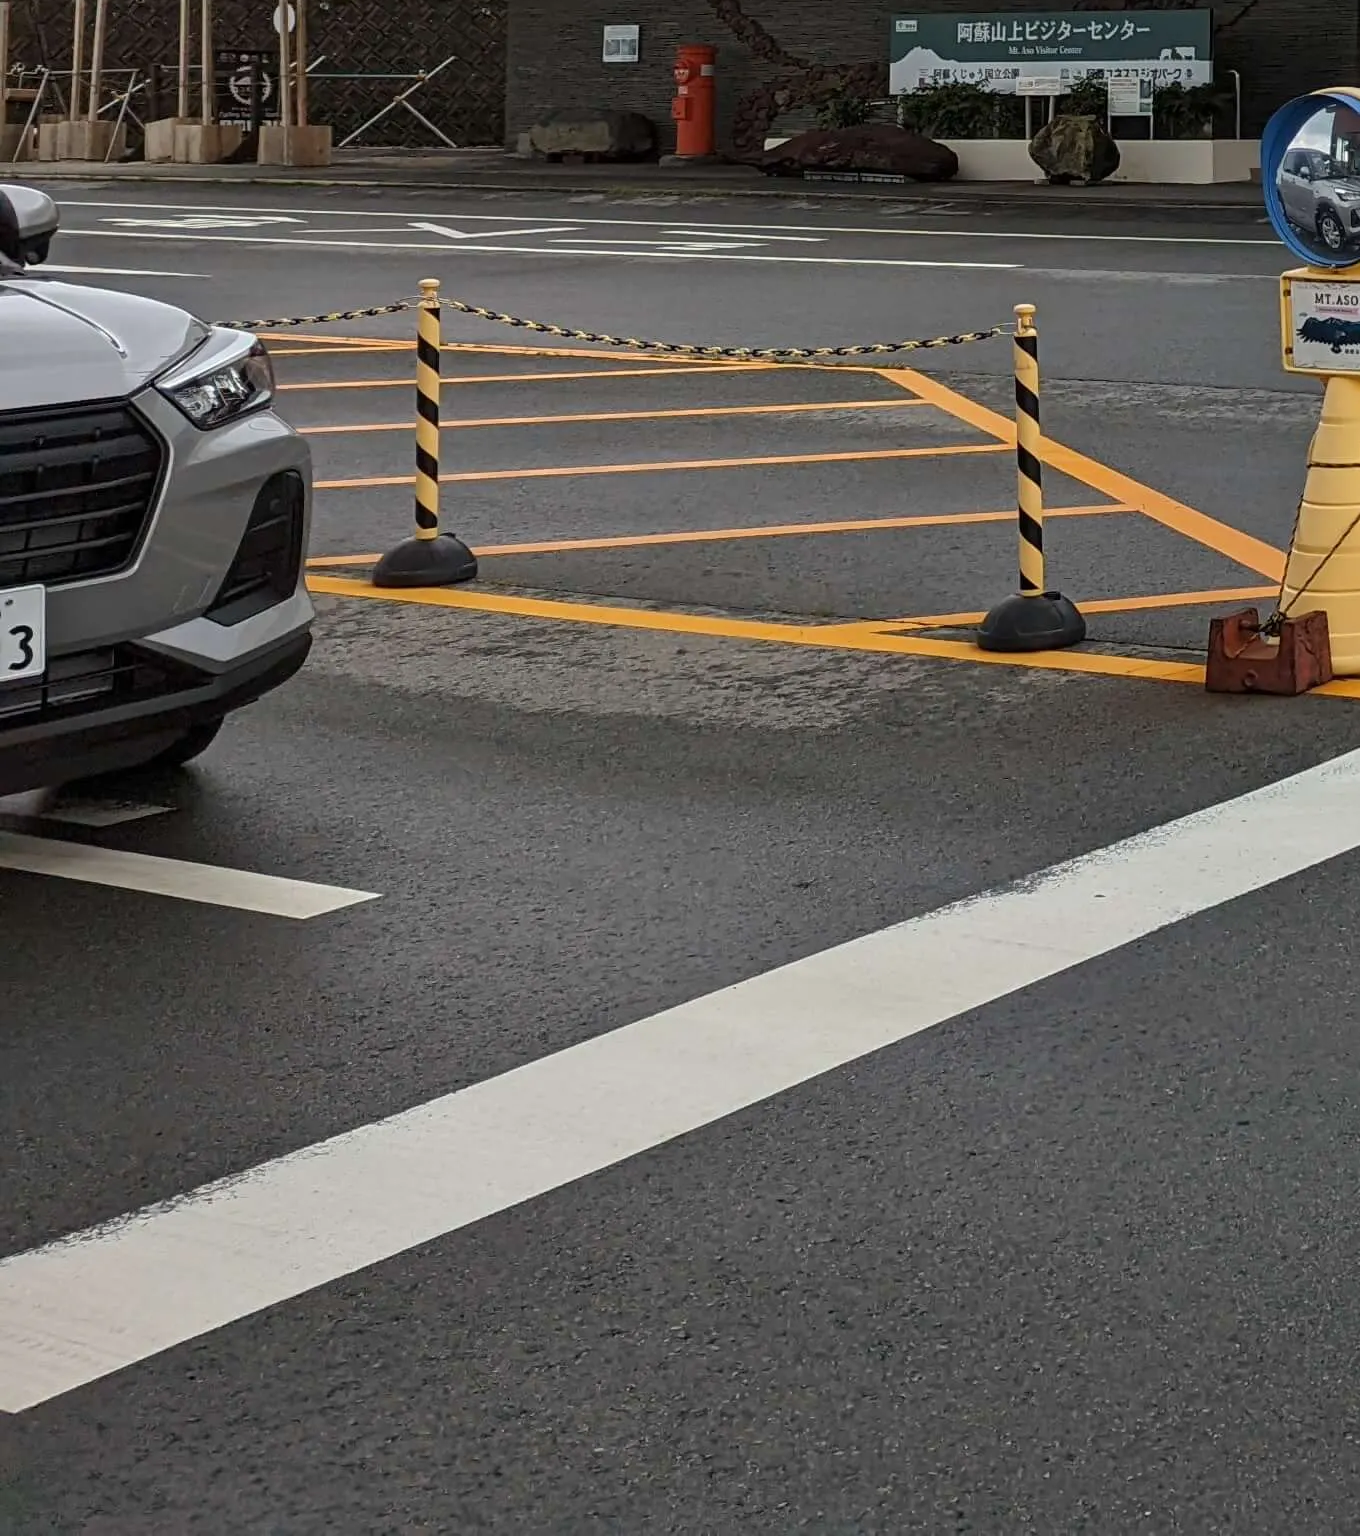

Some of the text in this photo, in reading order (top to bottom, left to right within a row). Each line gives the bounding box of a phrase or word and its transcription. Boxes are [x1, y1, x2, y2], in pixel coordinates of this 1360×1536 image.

[957, 19, 1151, 44] 阿蘇山上ビジターセンター
